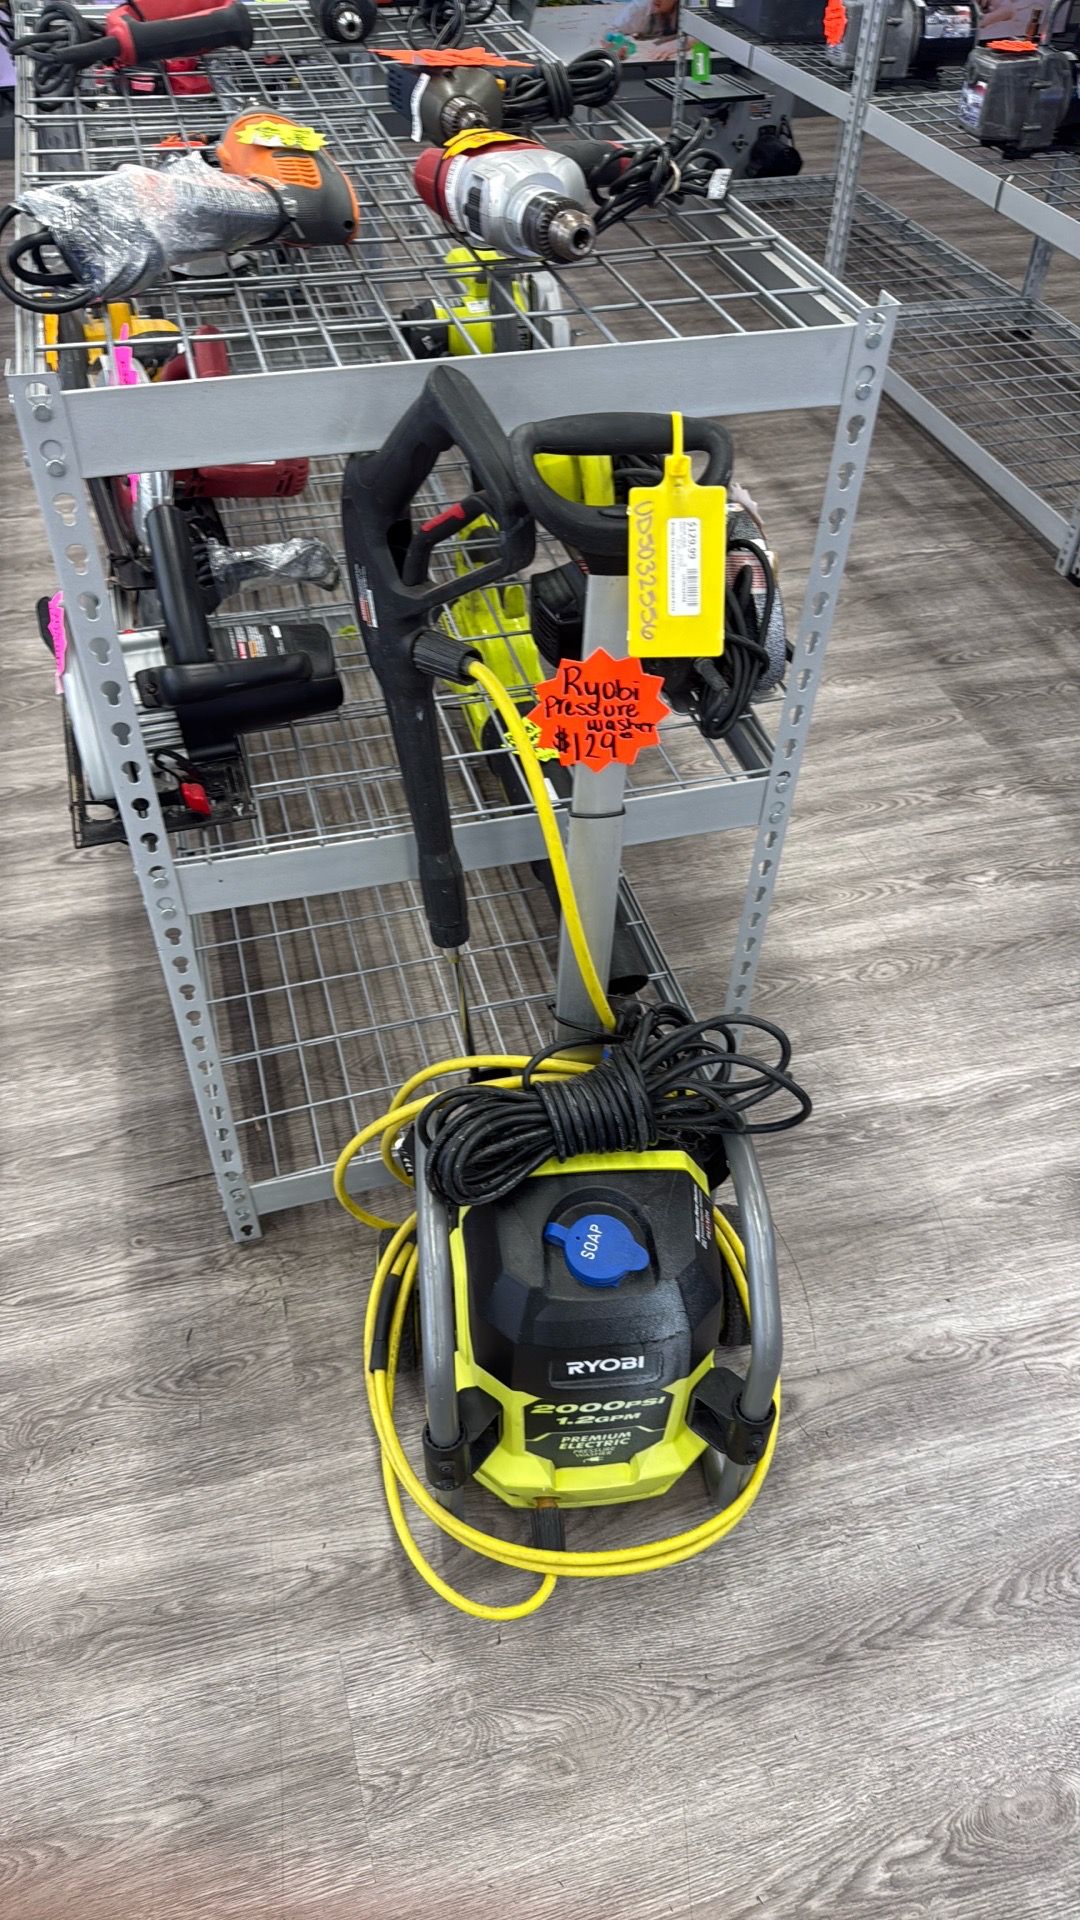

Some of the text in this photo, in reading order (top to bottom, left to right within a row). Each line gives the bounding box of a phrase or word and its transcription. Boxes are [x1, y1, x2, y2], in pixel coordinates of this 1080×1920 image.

[687, 521, 698, 560] $129.99
[564, 666, 639, 708] Ryobi
[580, 1223, 603, 1260] SOAP
[566, 1356, 644, 1375] RYOBI
[531, 1396, 667, 1414] 2000PSI
[556, 1412, 642, 1426] 1.2GPM
[559, 1438, 631, 1450] ELECTRIC
[561, 1431, 632, 1443] PREMIUM
